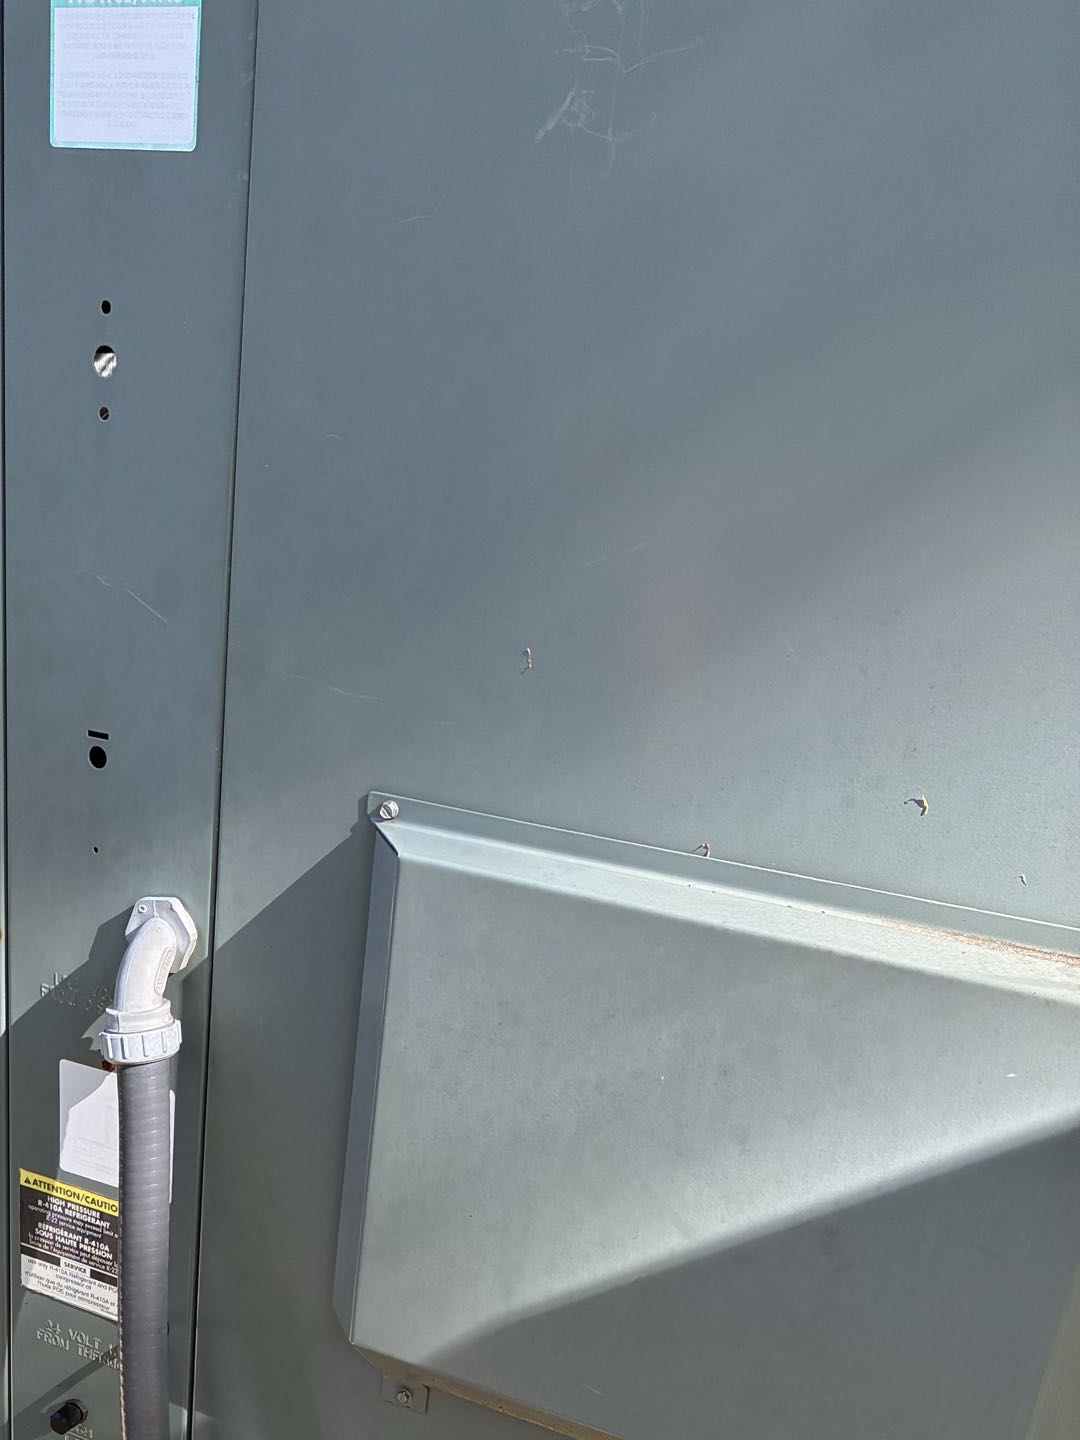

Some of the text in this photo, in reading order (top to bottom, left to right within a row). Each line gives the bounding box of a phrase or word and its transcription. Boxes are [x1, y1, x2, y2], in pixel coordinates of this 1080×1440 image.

[33, 1177, 118, 1214] ATTENTION/CAUTIO
[47, 1195, 100, 1219] HIGH PRESSURE
[37, 1199, 109, 1229] R-410A REFRIGERANT
[35, 1227, 112, 1260] SOUS HAUTE PRESSION
[84, 1237, 109, 1251] R-410A
[63, 1261, 86, 1274] SERVICE
